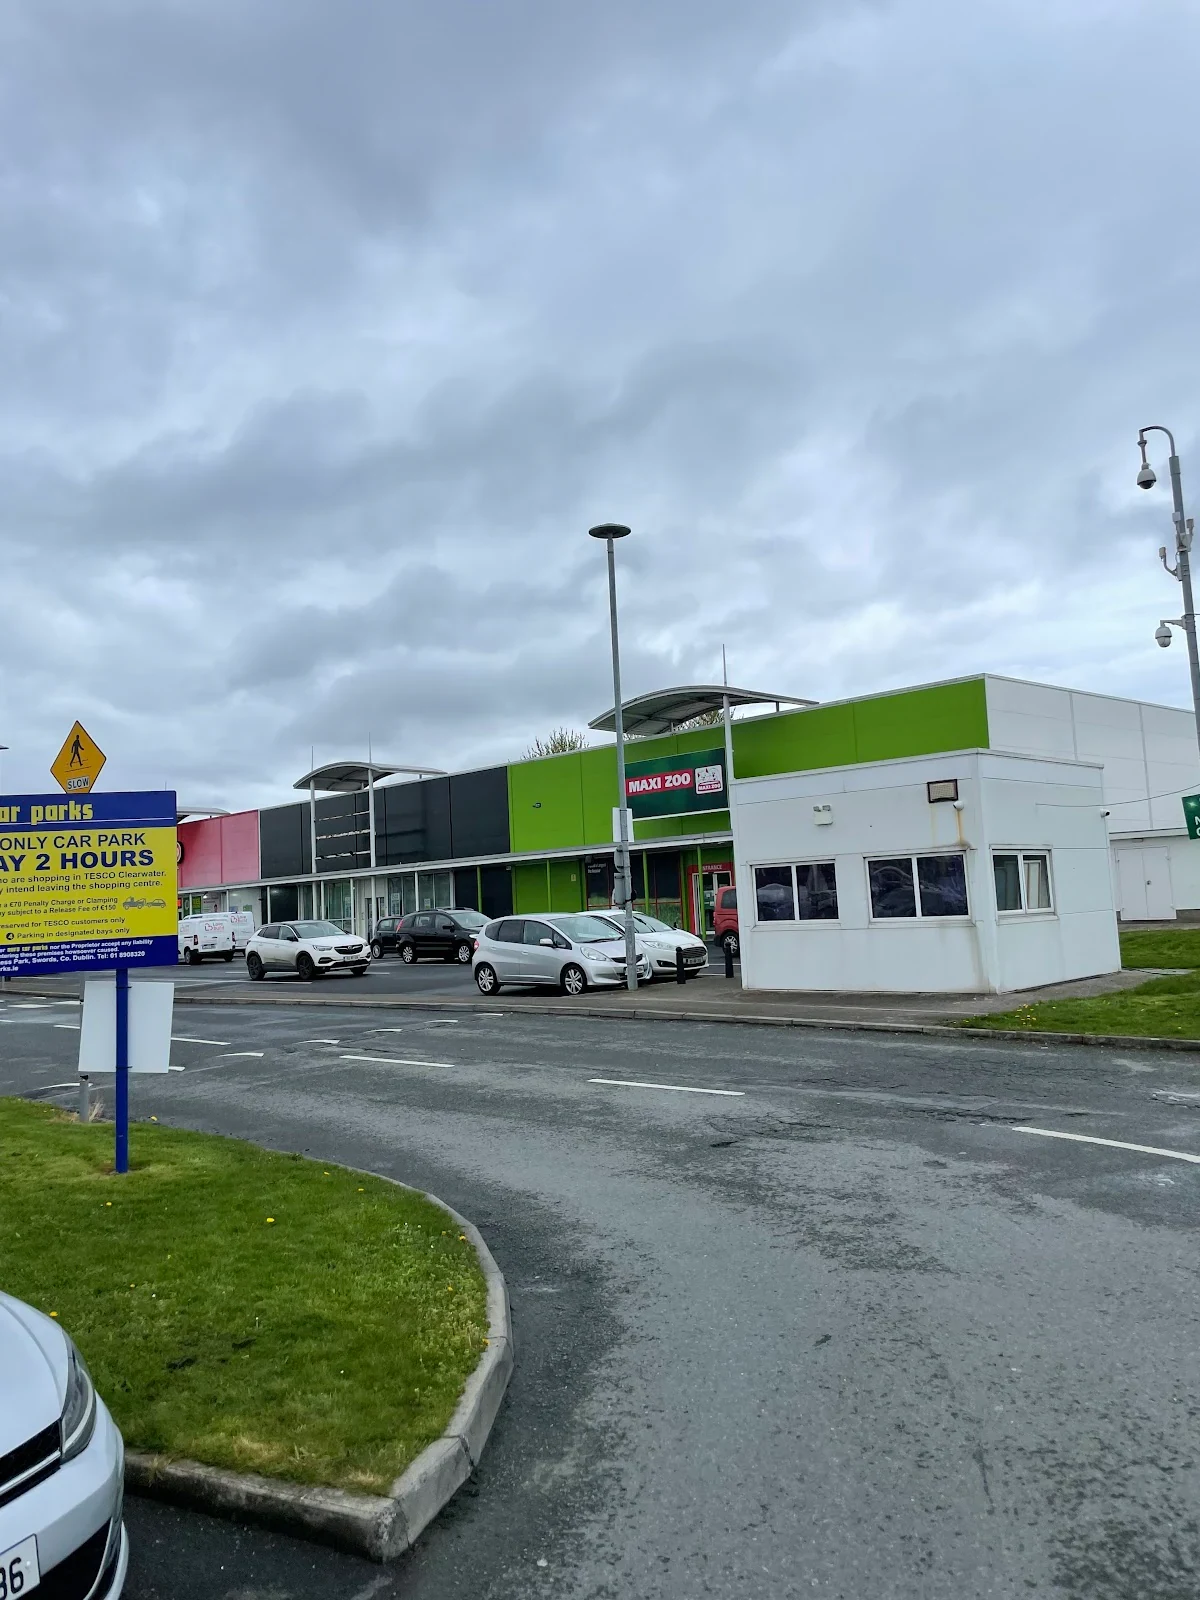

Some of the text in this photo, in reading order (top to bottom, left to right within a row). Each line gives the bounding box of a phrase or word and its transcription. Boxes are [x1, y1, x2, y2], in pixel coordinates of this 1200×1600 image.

[67, 778, 89, 789] SLOW
[628, 772, 691, 793] MAXI ZOO
[31, 800, 93, 825] parks
[0, 833, 146, 851] ONLY CAR PARK
[36, 853, 50, 871] 2
[61, 849, 154, 870] HOURS
[28, 874, 70, 883] shopping
[84, 872, 116, 880] TESCO
[118, 870, 166, 879] Clearwater.
[6, 885, 35, 893] intend
[37, 884, 70, 892] leaving
[72, 882, 86, 890] the
[89, 881, 131, 890] shopping
[86, 896, 118, 905] Clamping
[43, 919, 69, 927] TESCO
[71, 918, 108, 926] customers
[55, 928, 94, 937] designated
[97, 927, 113, 935] bays
